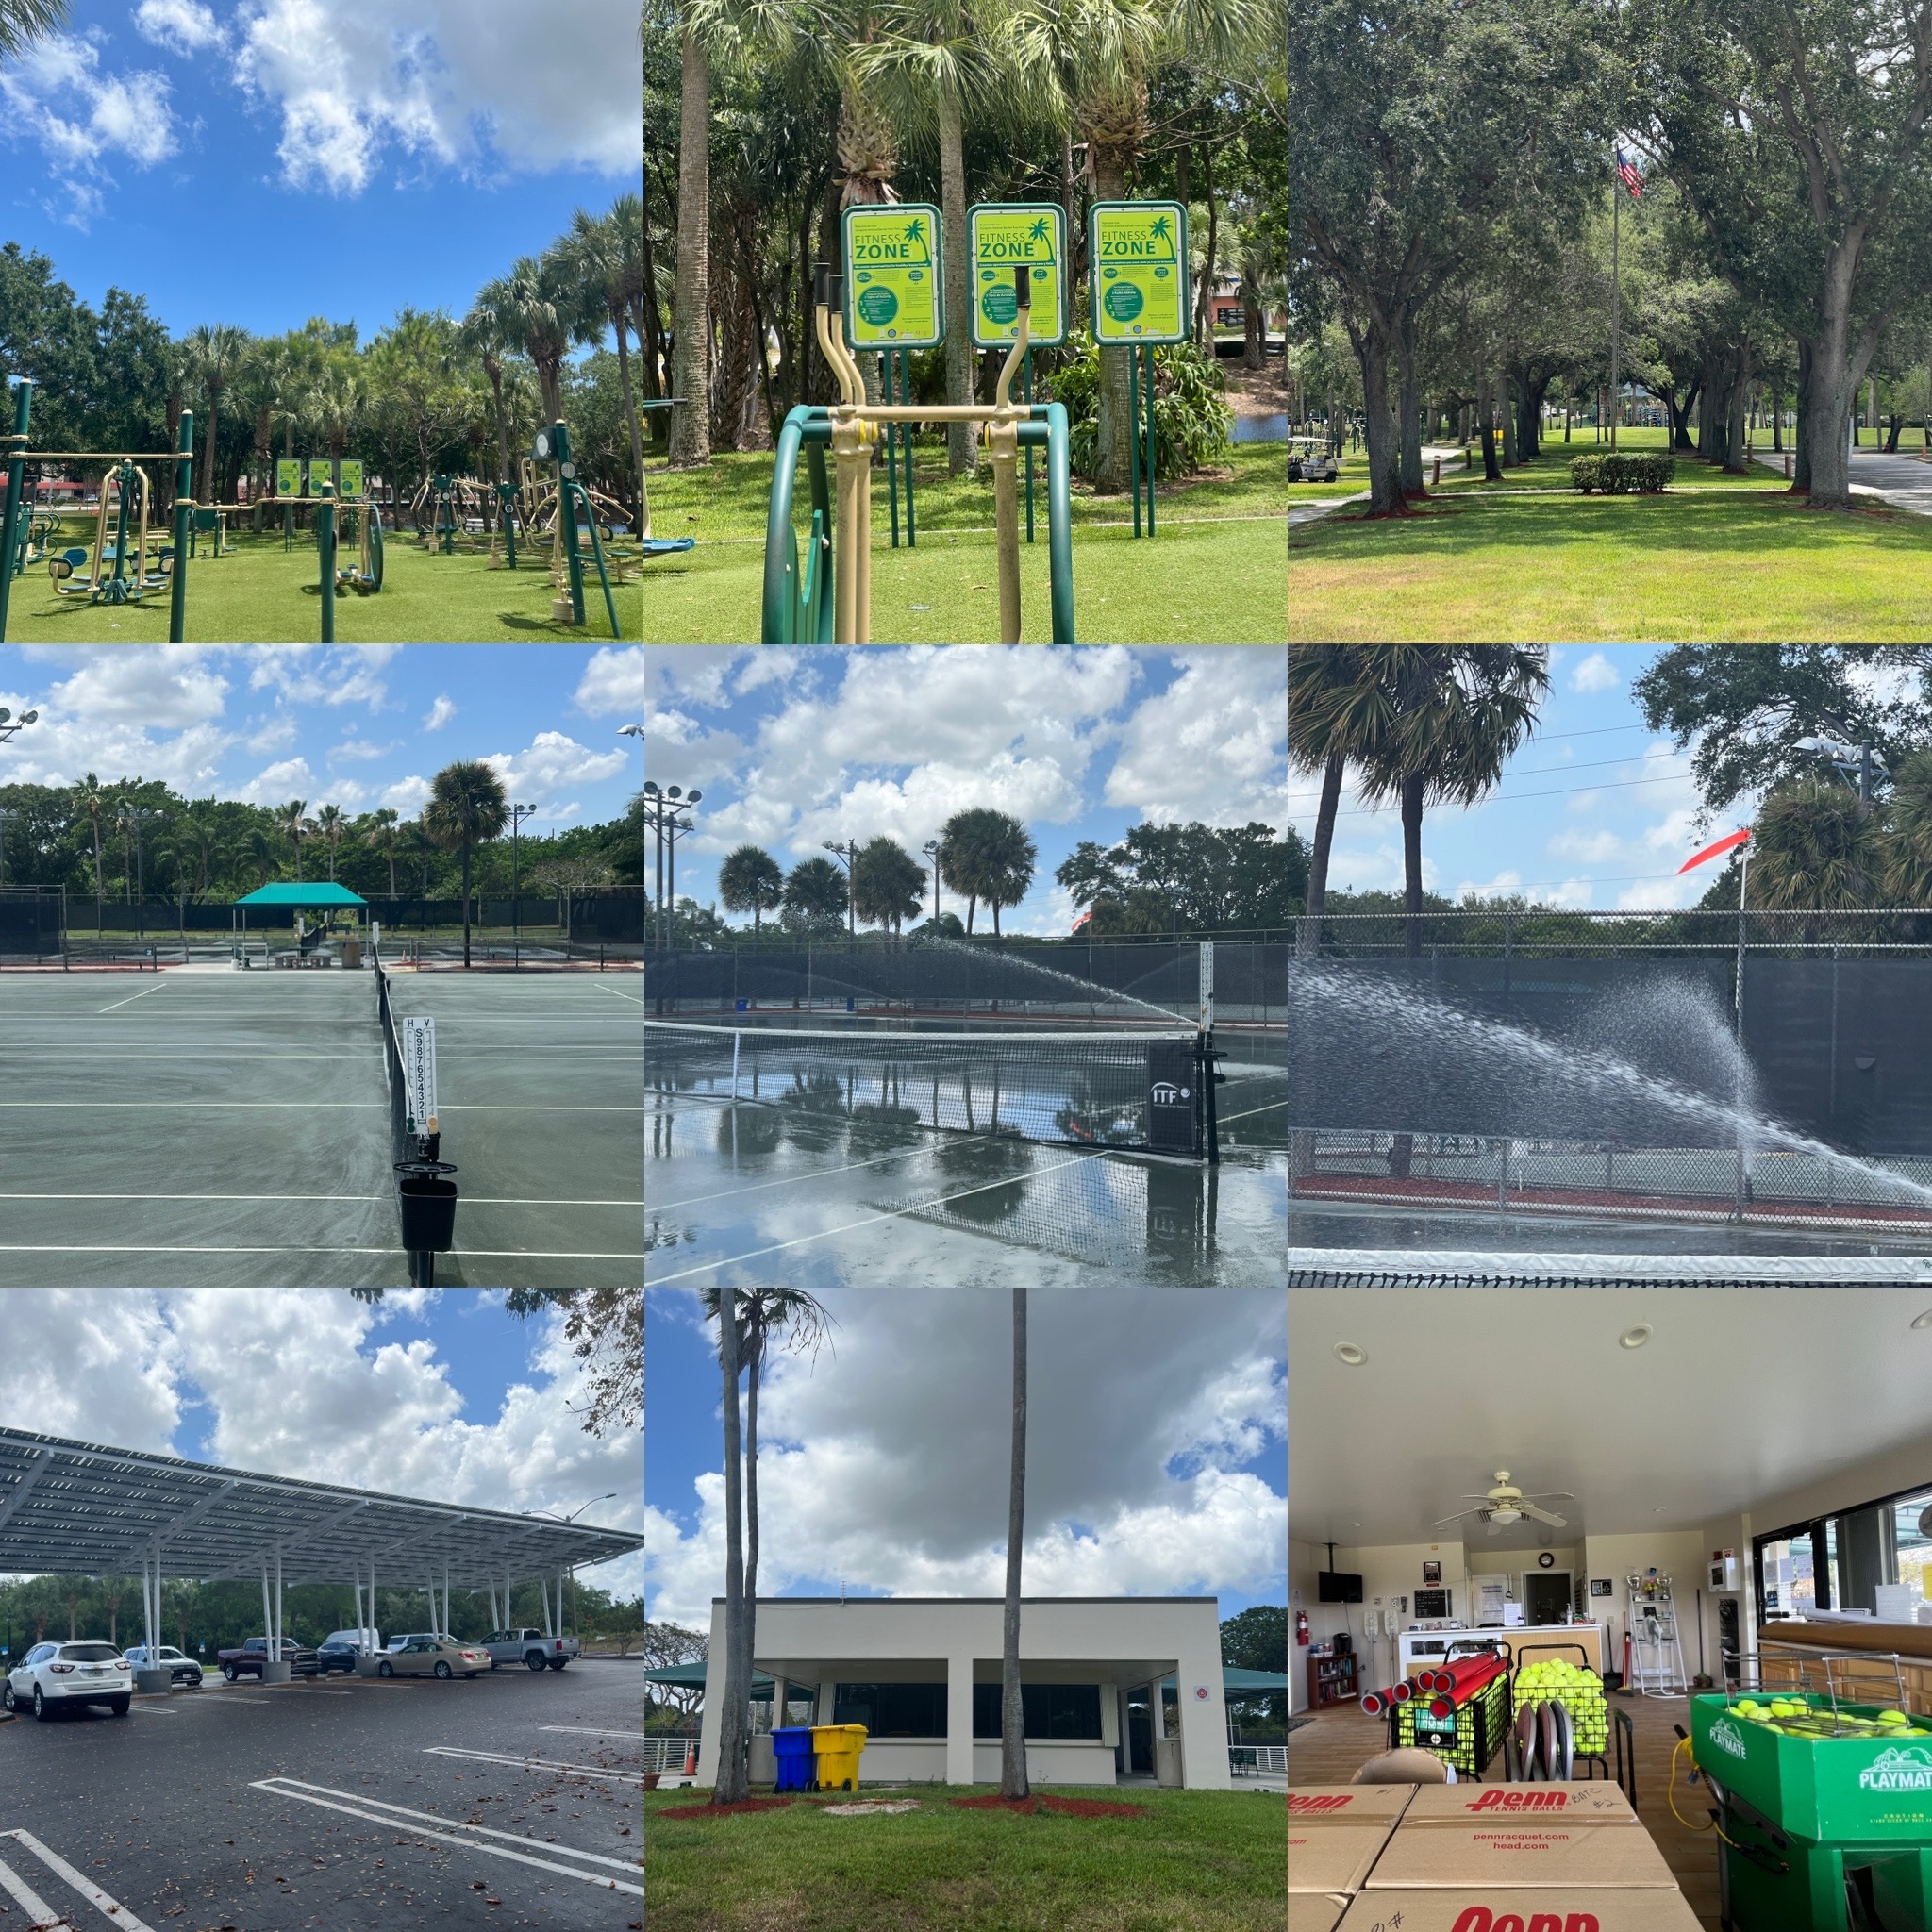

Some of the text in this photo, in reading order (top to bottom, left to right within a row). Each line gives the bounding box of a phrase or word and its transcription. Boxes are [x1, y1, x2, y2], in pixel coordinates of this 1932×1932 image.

[855, 234, 901, 244] FITNESS
[980, 233, 1025, 242] FITNESS
[1102, 231, 1146, 241] FITNESS
[855, 244, 909, 258] ZONE
[980, 242, 1034, 258] ZONE
[1102, 241, 1156, 255] ZONE
[408, 1019, 430, 1027] H V
[1154, 1090, 1177, 1104] ITF
[1709, 1728, 1746, 1760] PLAYMATE
[1464, 1790, 1568, 1811] Penn
